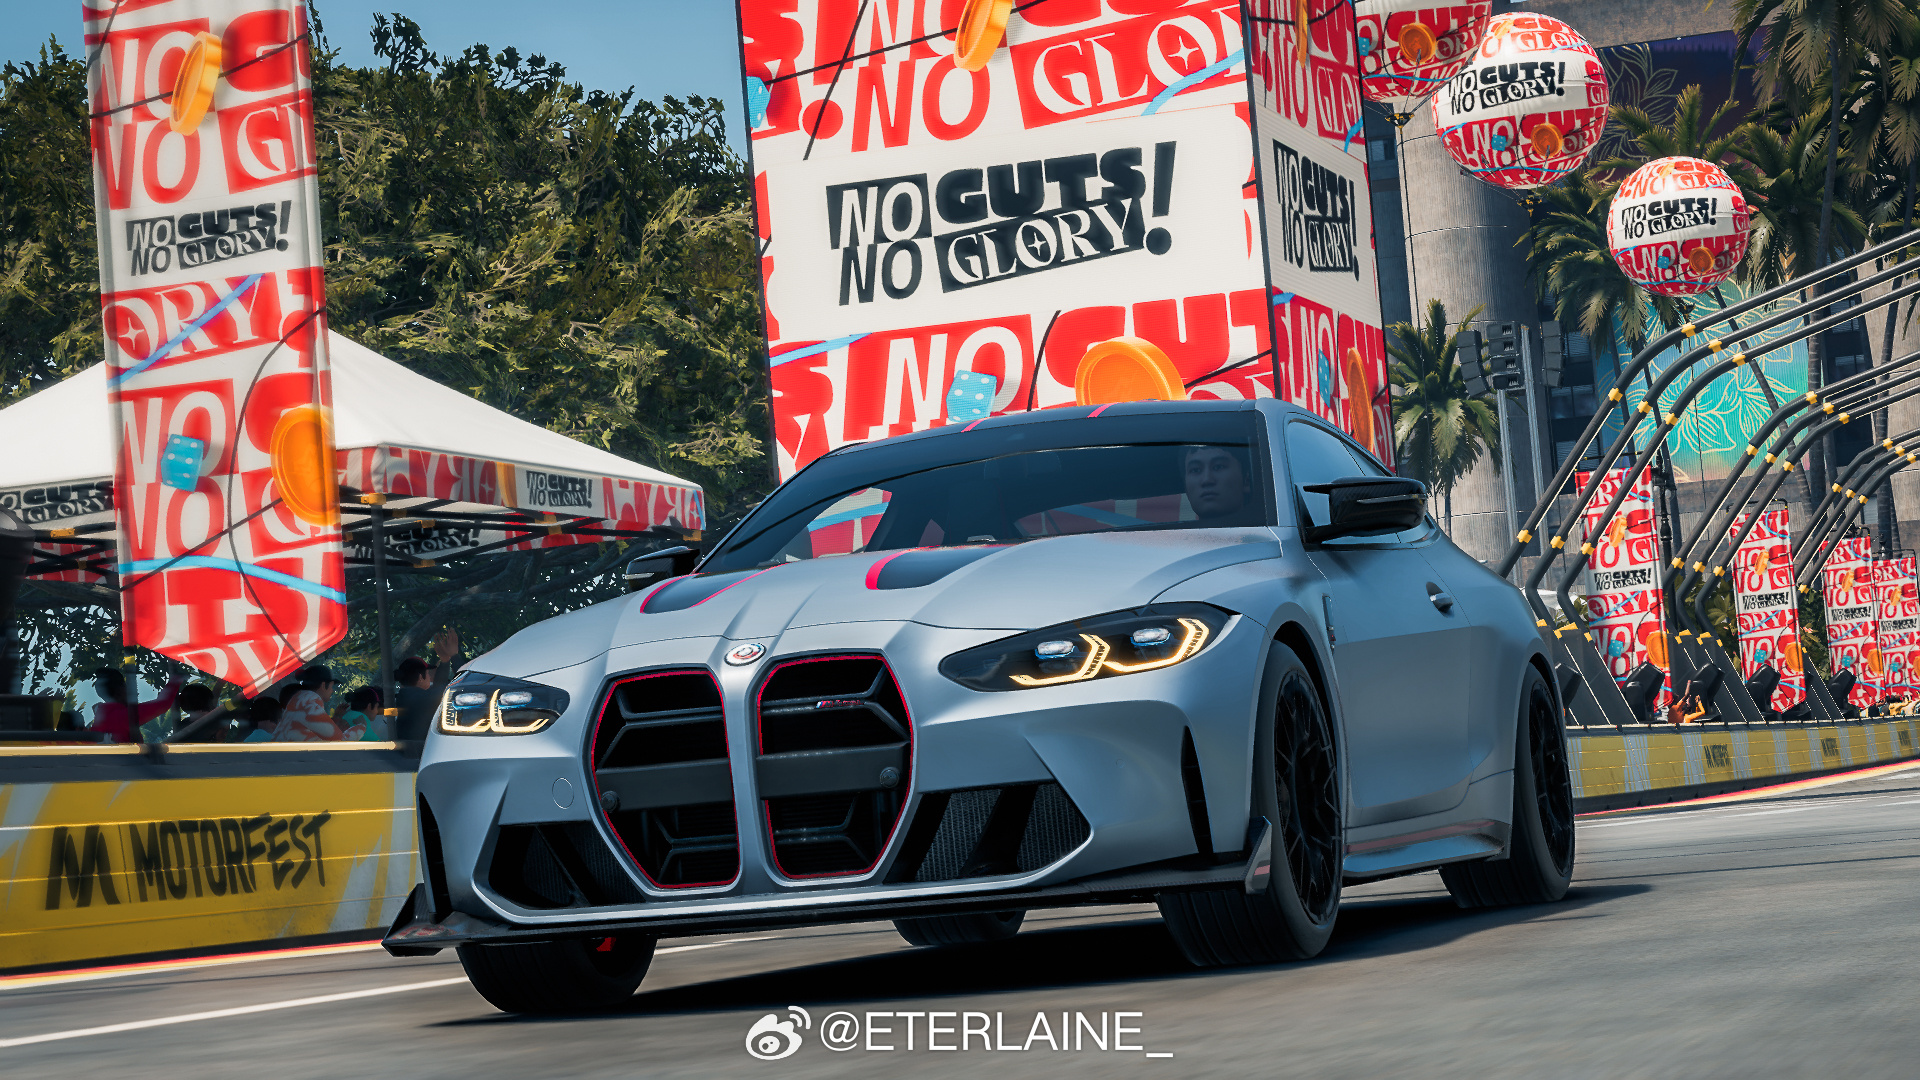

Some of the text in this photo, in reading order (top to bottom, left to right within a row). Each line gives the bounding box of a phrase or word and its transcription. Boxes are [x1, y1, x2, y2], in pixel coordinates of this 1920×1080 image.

[851, 54, 990, 152] NO
[1449, 70, 1477, 96] NO
[1452, 91, 1474, 115] NO
[1275, 143, 1301, 213] NO
[129, 217, 174, 250] NO
[830, 175, 931, 248] NO
[1622, 205, 1646, 224] NO
[1624, 221, 1644, 240] NO
[131, 246, 171, 276] NO
[1281, 209, 1304, 268] NO
[839, 239, 922, 306] NO
[129, 810, 331, 903] MOTORFEST
